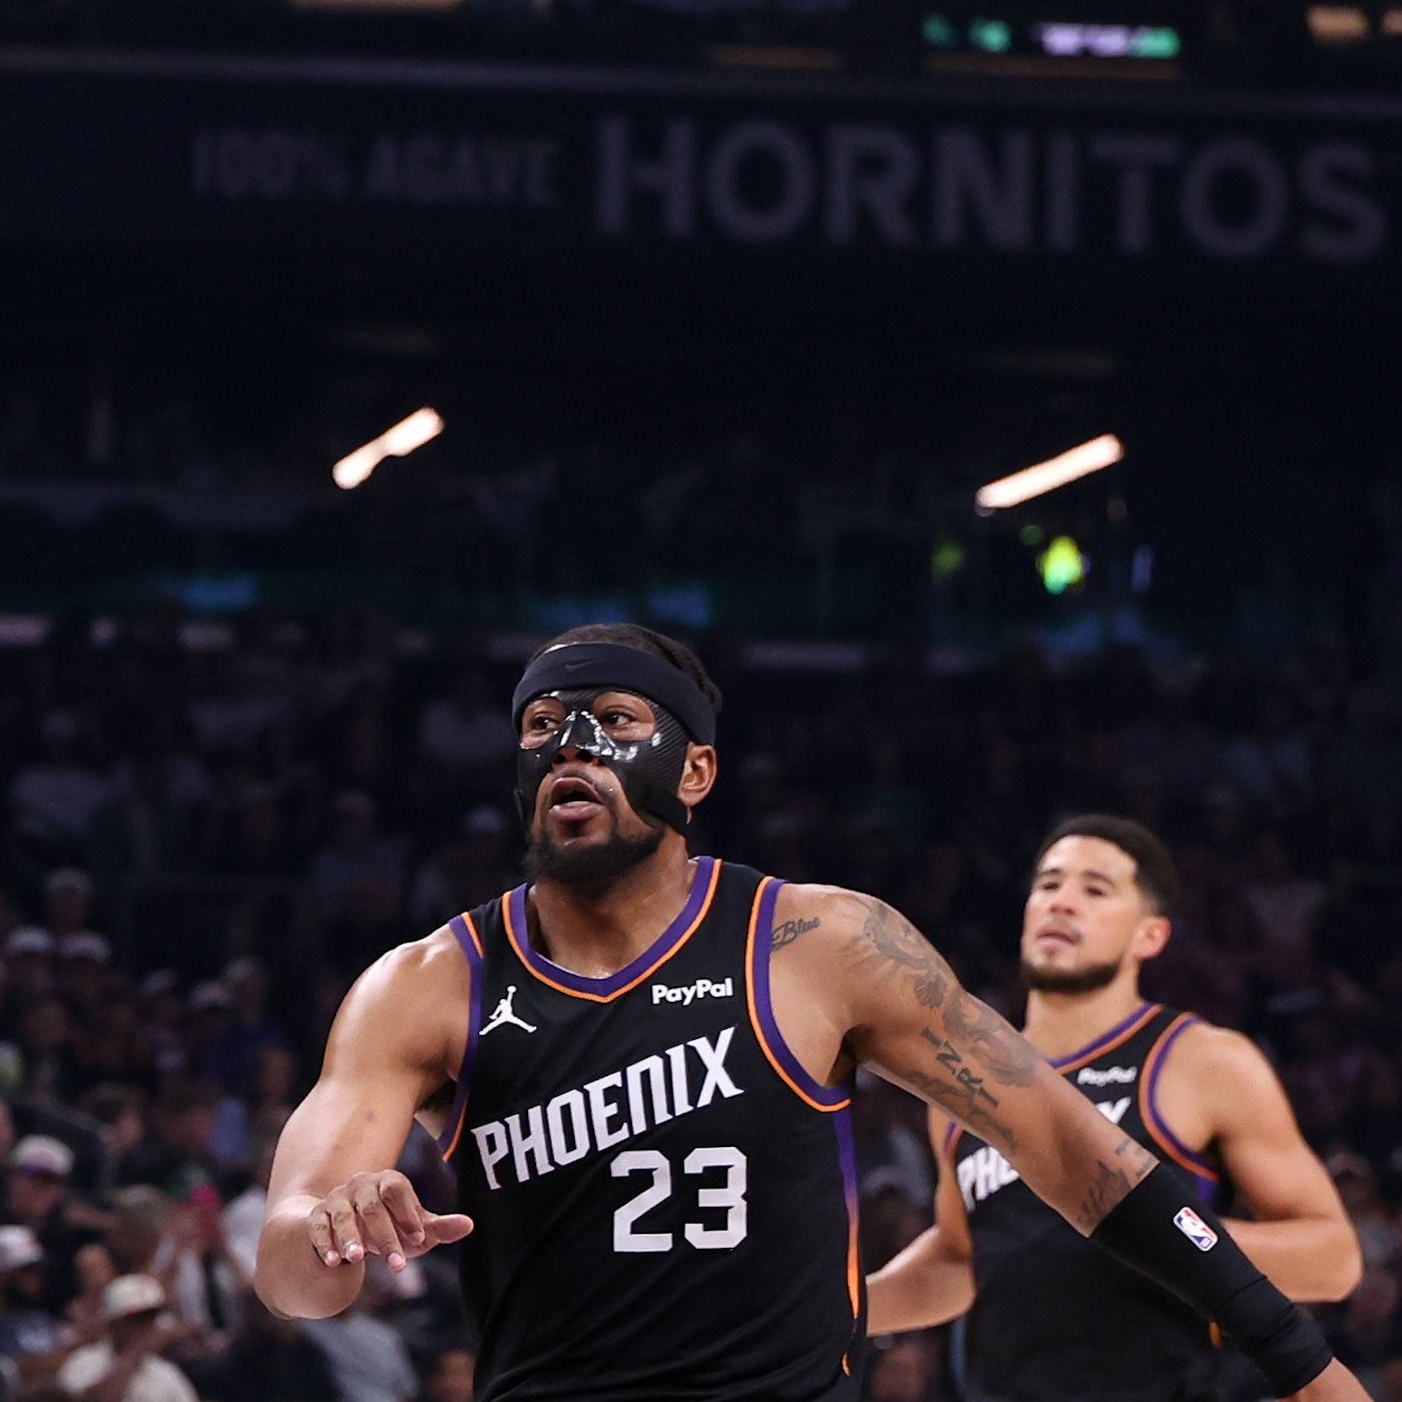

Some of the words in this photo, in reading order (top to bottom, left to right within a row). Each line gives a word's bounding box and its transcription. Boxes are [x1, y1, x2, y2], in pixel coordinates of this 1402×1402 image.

[365, 131, 560, 208] AGAVE
[595, 115, 1386, 261] HORNITOS
[652, 977, 734, 1006] PayPal
[470, 1026, 745, 1190] PHOENIX
[610, 1146, 748, 1252] 23
